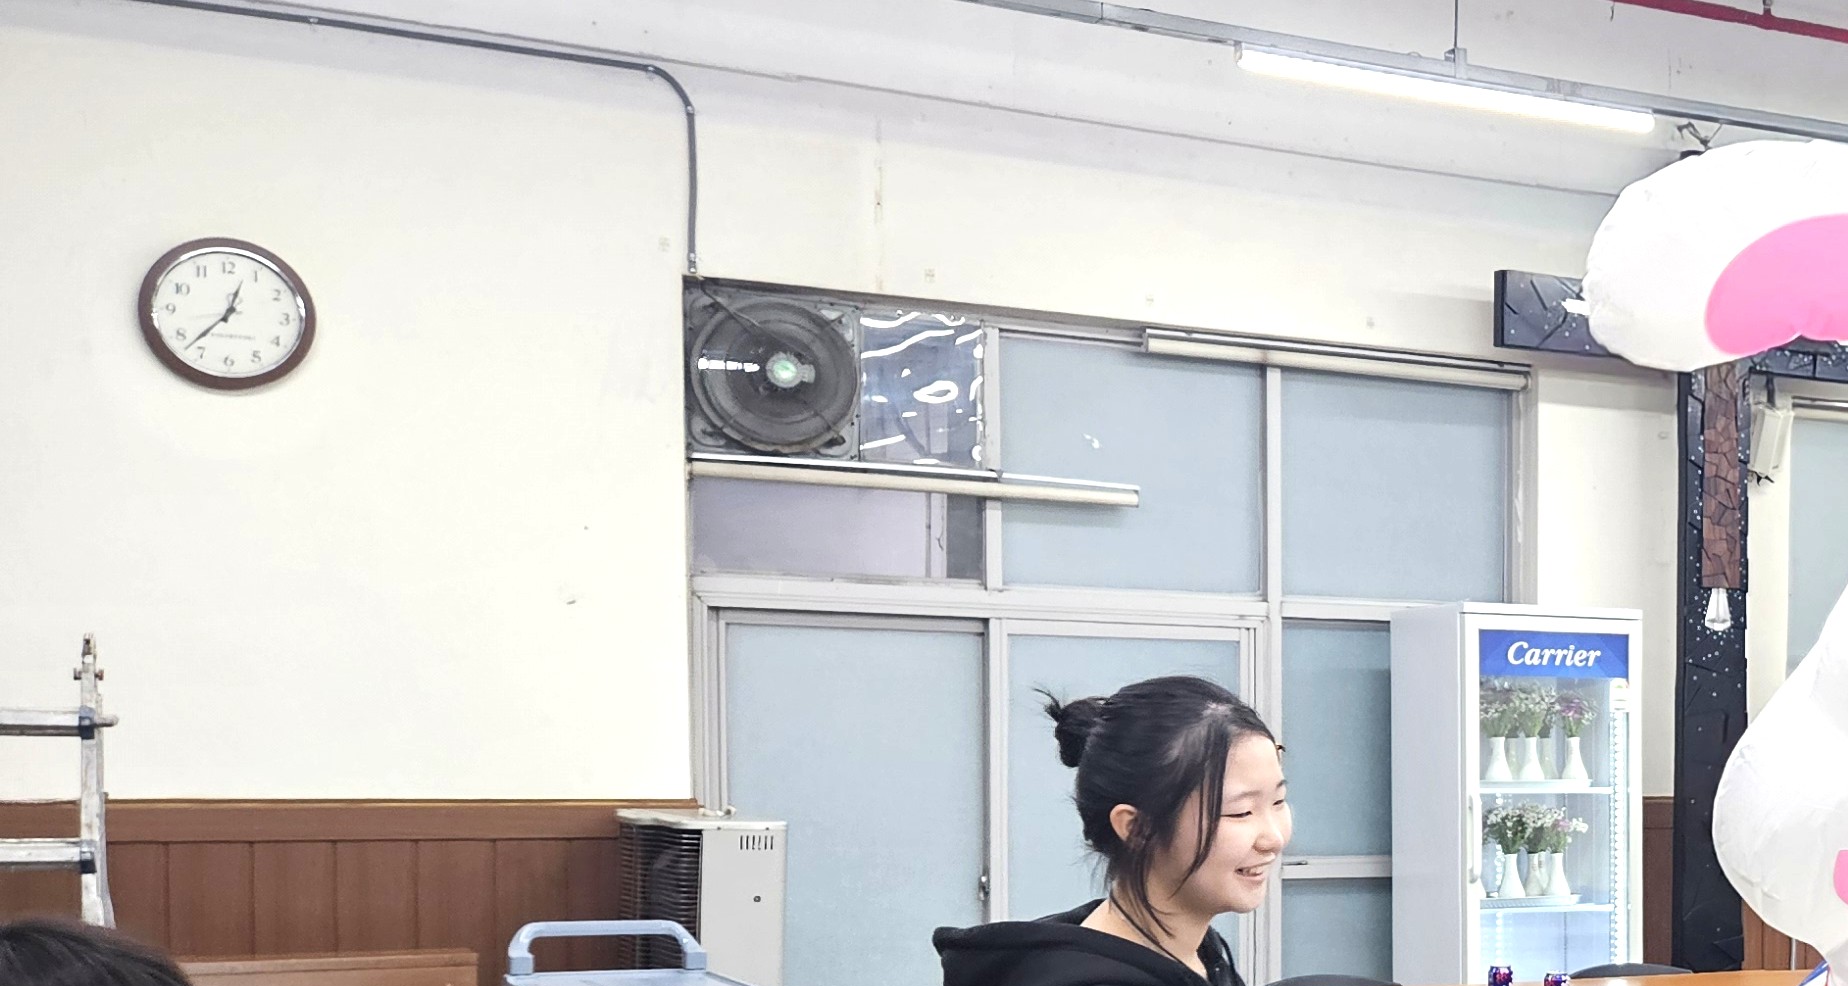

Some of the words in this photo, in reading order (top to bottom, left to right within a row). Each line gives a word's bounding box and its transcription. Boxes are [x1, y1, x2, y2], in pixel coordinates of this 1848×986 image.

[195, 265, 207, 278] 11
[222, 261, 236, 274] 12
[253, 270, 259, 282] 1
[175, 282, 190, 295] 10
[273, 289, 281, 301] 2
[165, 303, 176, 314] 9
[279, 312, 290, 326] 3
[176, 328, 187, 341] 8
[270, 336, 280, 347] 4
[197, 346, 206, 359] 7
[251, 350, 262, 363] 5
[223, 355, 235, 367] 6
[1507, 641, 1602, 667] Carrier
